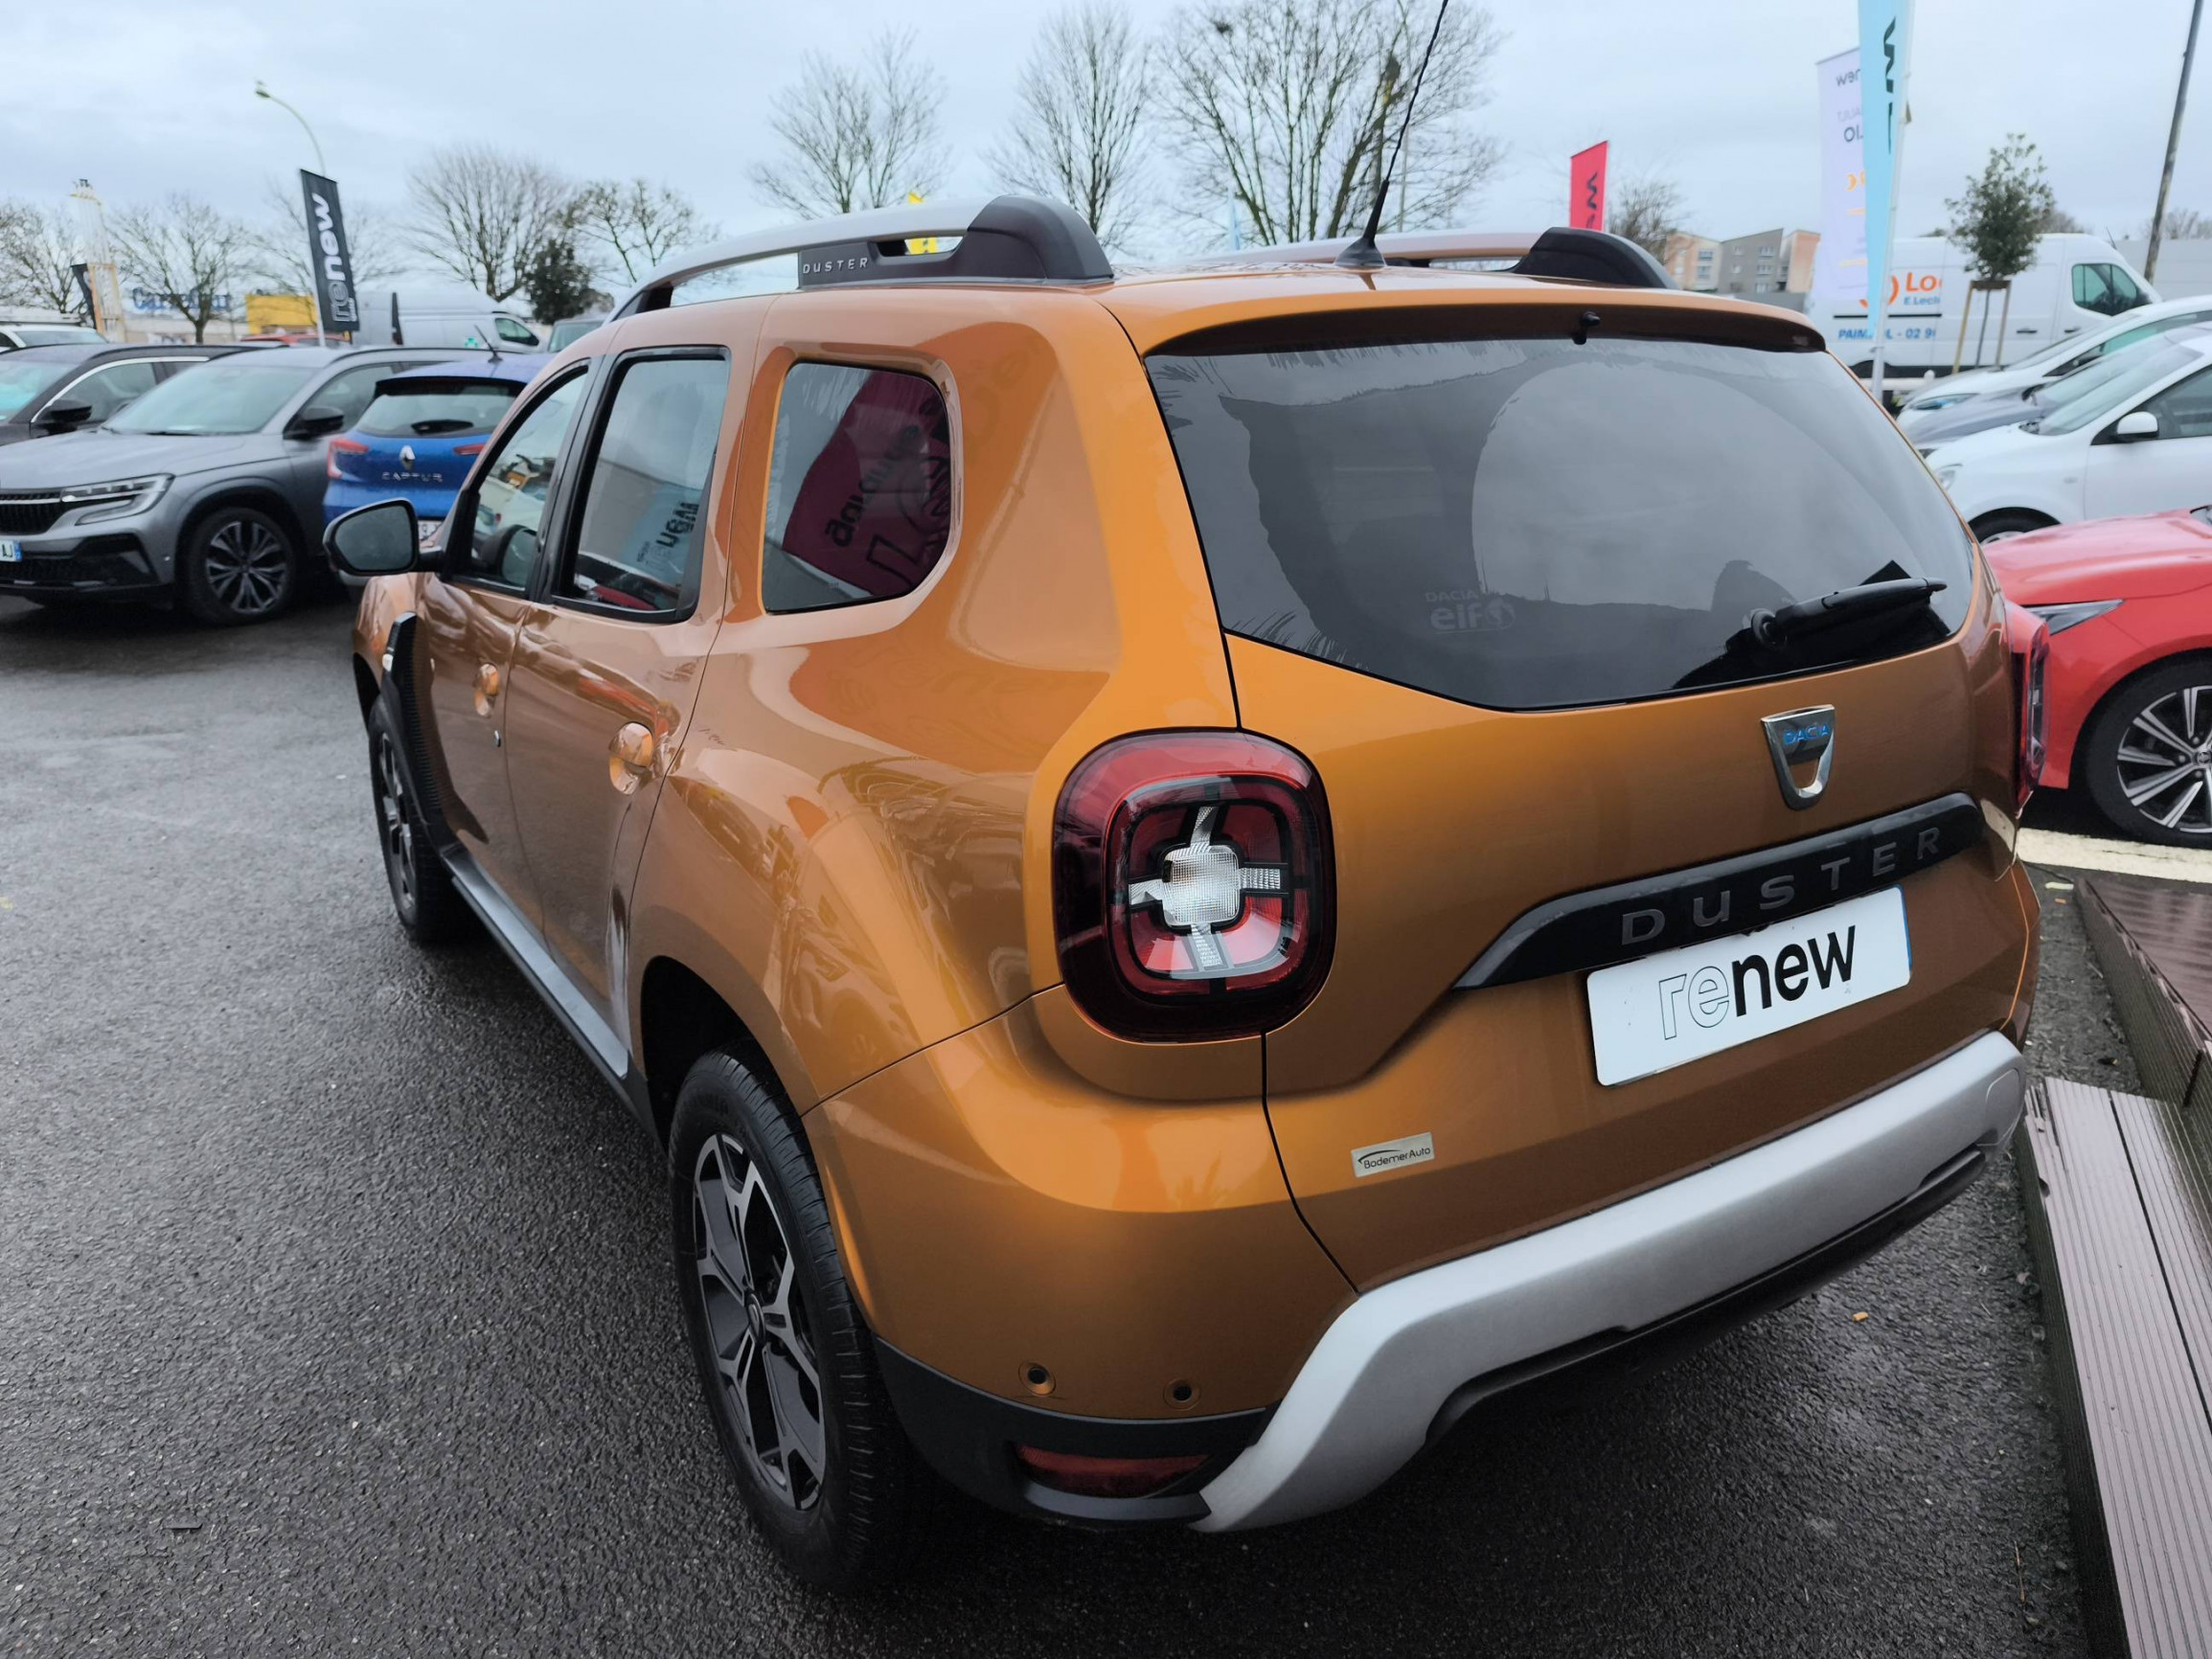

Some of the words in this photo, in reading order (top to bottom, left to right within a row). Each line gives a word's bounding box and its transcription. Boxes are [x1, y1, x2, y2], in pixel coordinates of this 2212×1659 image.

[311, 192, 351, 322] renew
[803, 258, 868, 274] DUSTER
[1905, 271, 1942, 292] Lo
[1905, 328, 1921, 339] 02
[1425, 589, 1478, 602] DACIA
[1430, 602, 1482, 629] elf
[1784, 723, 1831, 744] DACIA
[1622, 827, 1940, 945] DUSTER
[1658, 925, 1856, 1040] renew
